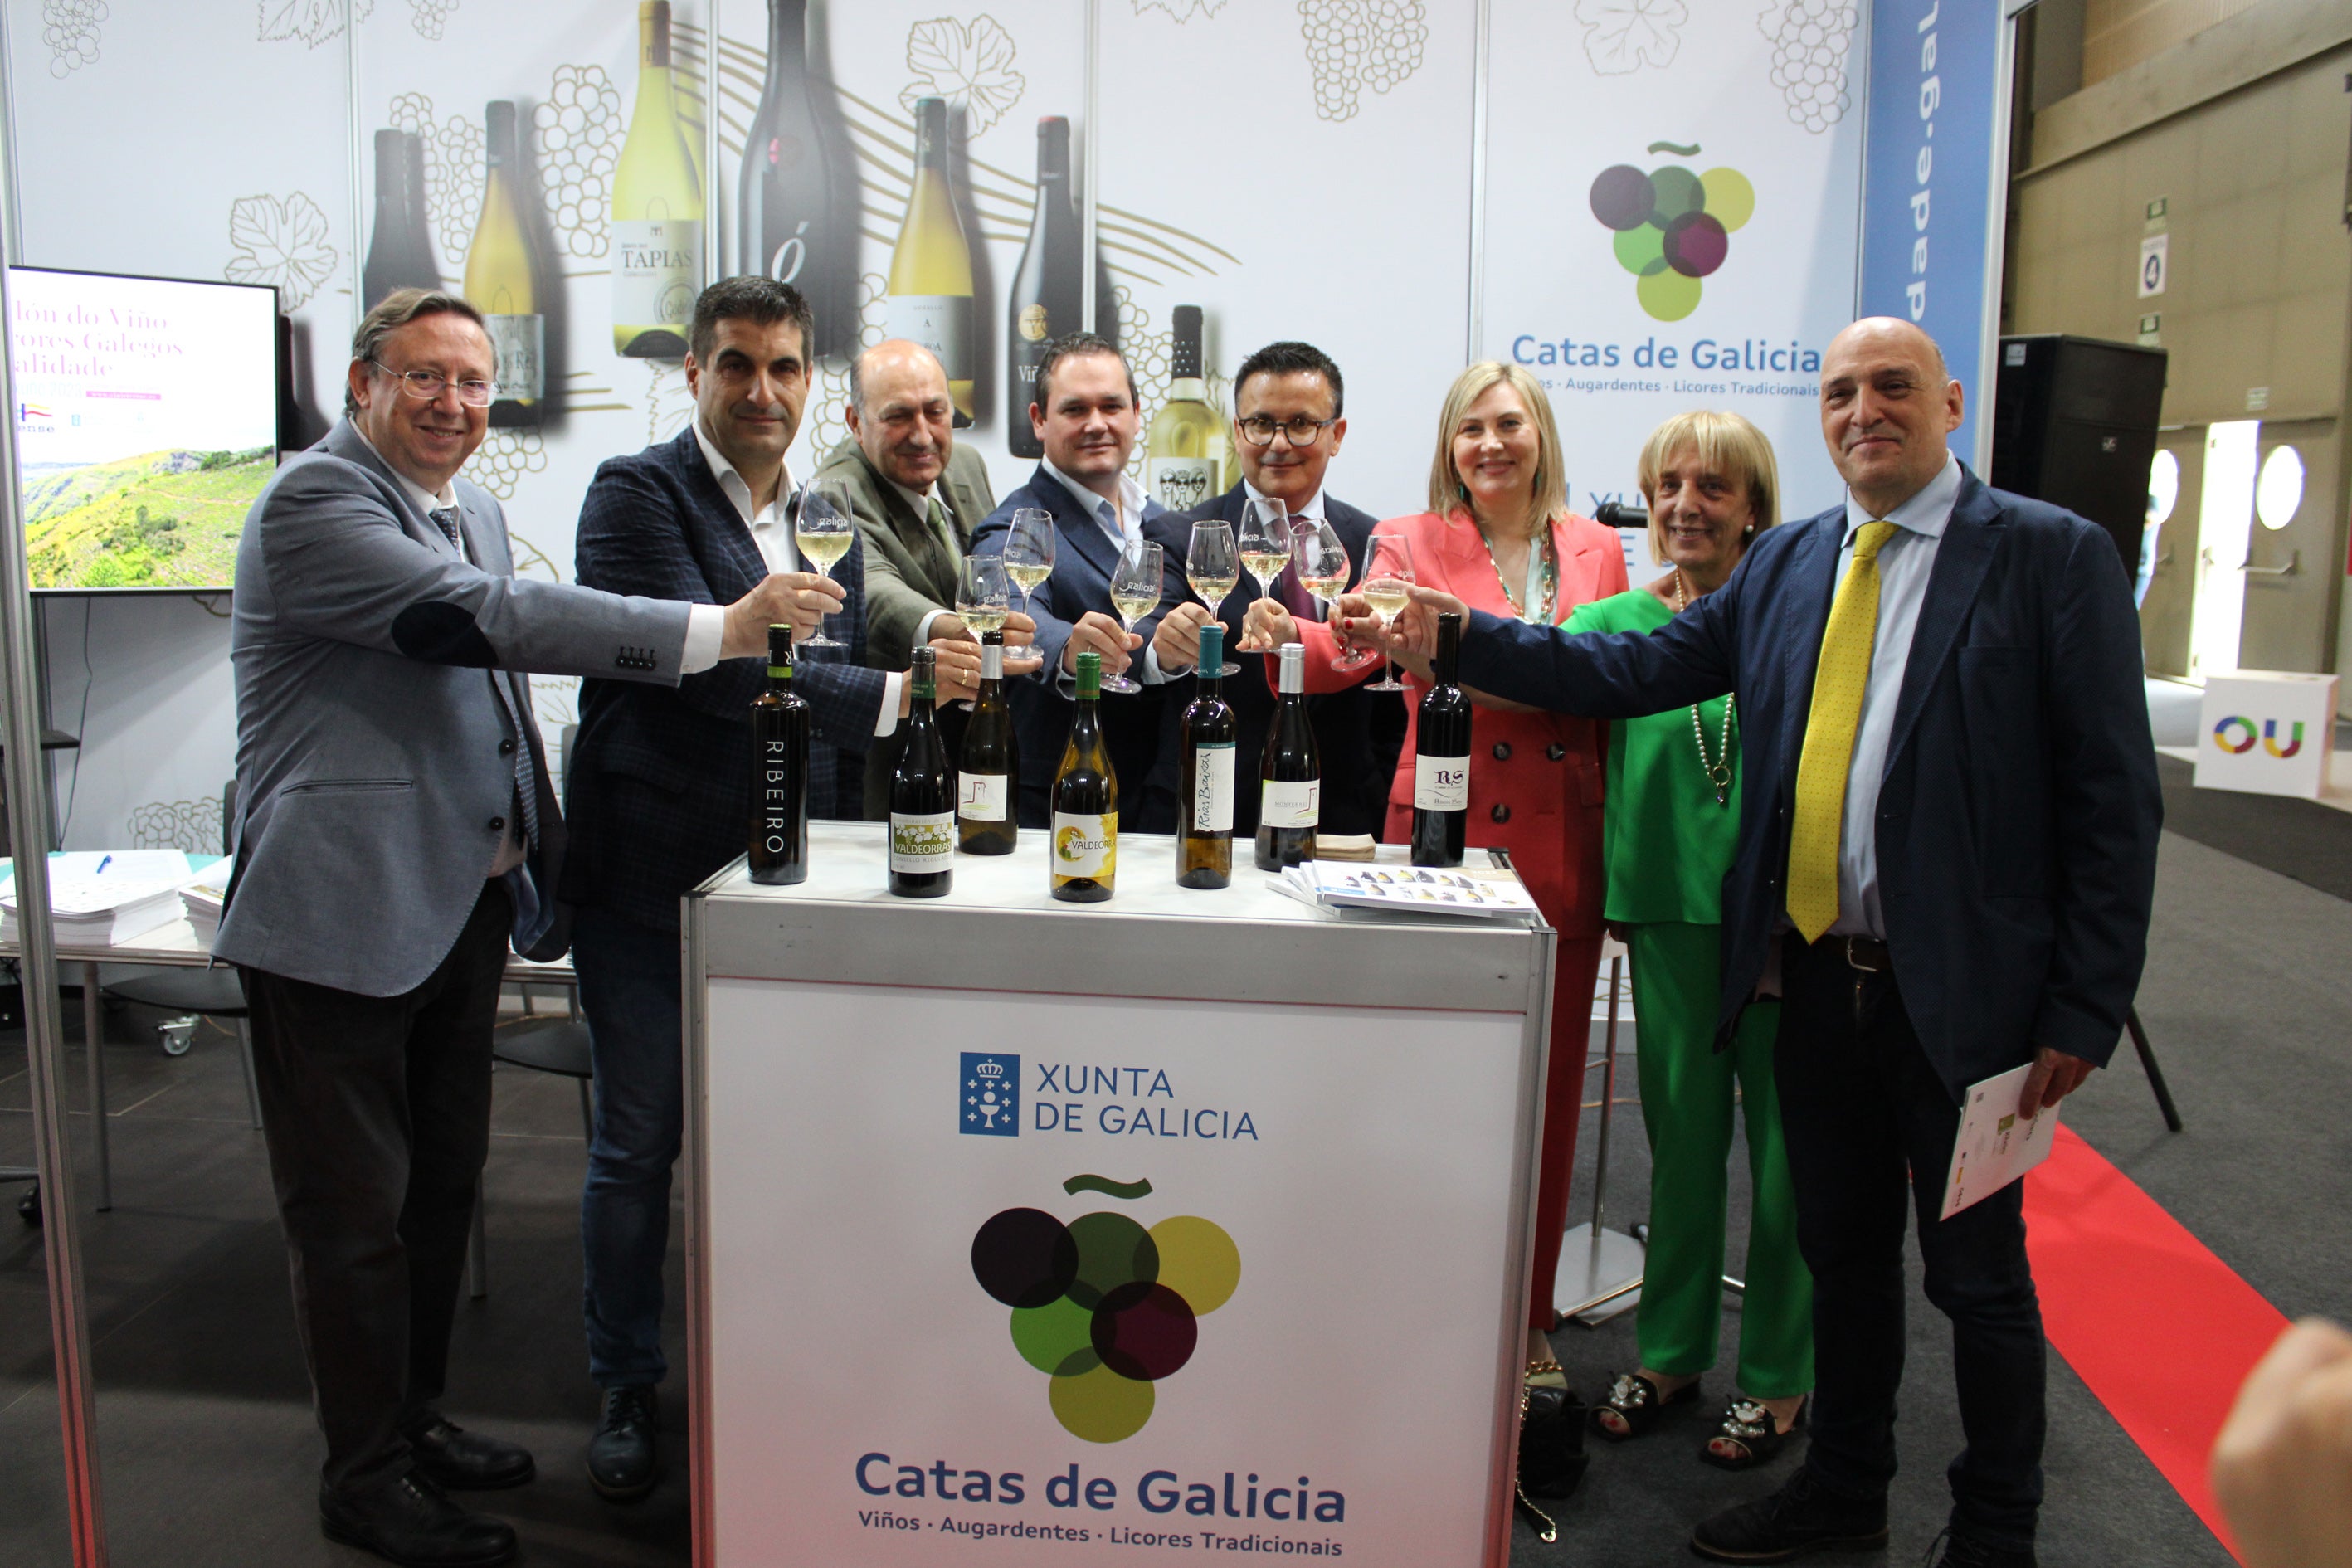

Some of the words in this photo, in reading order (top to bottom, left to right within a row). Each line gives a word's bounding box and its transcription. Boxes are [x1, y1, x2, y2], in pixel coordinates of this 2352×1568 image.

[622, 250, 692, 268] TAPIAS
[67, 305, 99, 324] do
[16, 334, 74, 349] ores
[83, 333, 183, 358] Galegos
[1512, 334, 1620, 367] Catas
[1634, 336, 1679, 368] de
[1691, 338, 1821, 373] Galicia
[1566, 378, 1661, 394] Augardentes
[1673, 381, 1726, 394] Licores
[1731, 381, 1820, 397] Tradicionais
[809, 516, 848, 530] galicia
[1118, 581, 1156, 593] galicia
[2213, 716, 2306, 759] OU
[1197, 752, 1211, 799] Baixas
[767, 741, 784, 853] RIBEIRO
[894, 842, 951, 855] VALDEORRAS
[1037, 1063, 1174, 1098] XUNTA
[1035, 1102, 1084, 1132] DE
[1098, 1104, 1259, 1141] GALICIA
[855, 1452, 1025, 1505] Catas
[1045, 1463, 1117, 1510] de
[1137, 1470, 1345, 1522] Galicia
[858, 1510, 920, 1531] Viños
[940, 1516, 1090, 1541] Augardentes
[1111, 1527, 1193, 1548] Licores
[1200, 1531, 1342, 1556] Tradicionais
